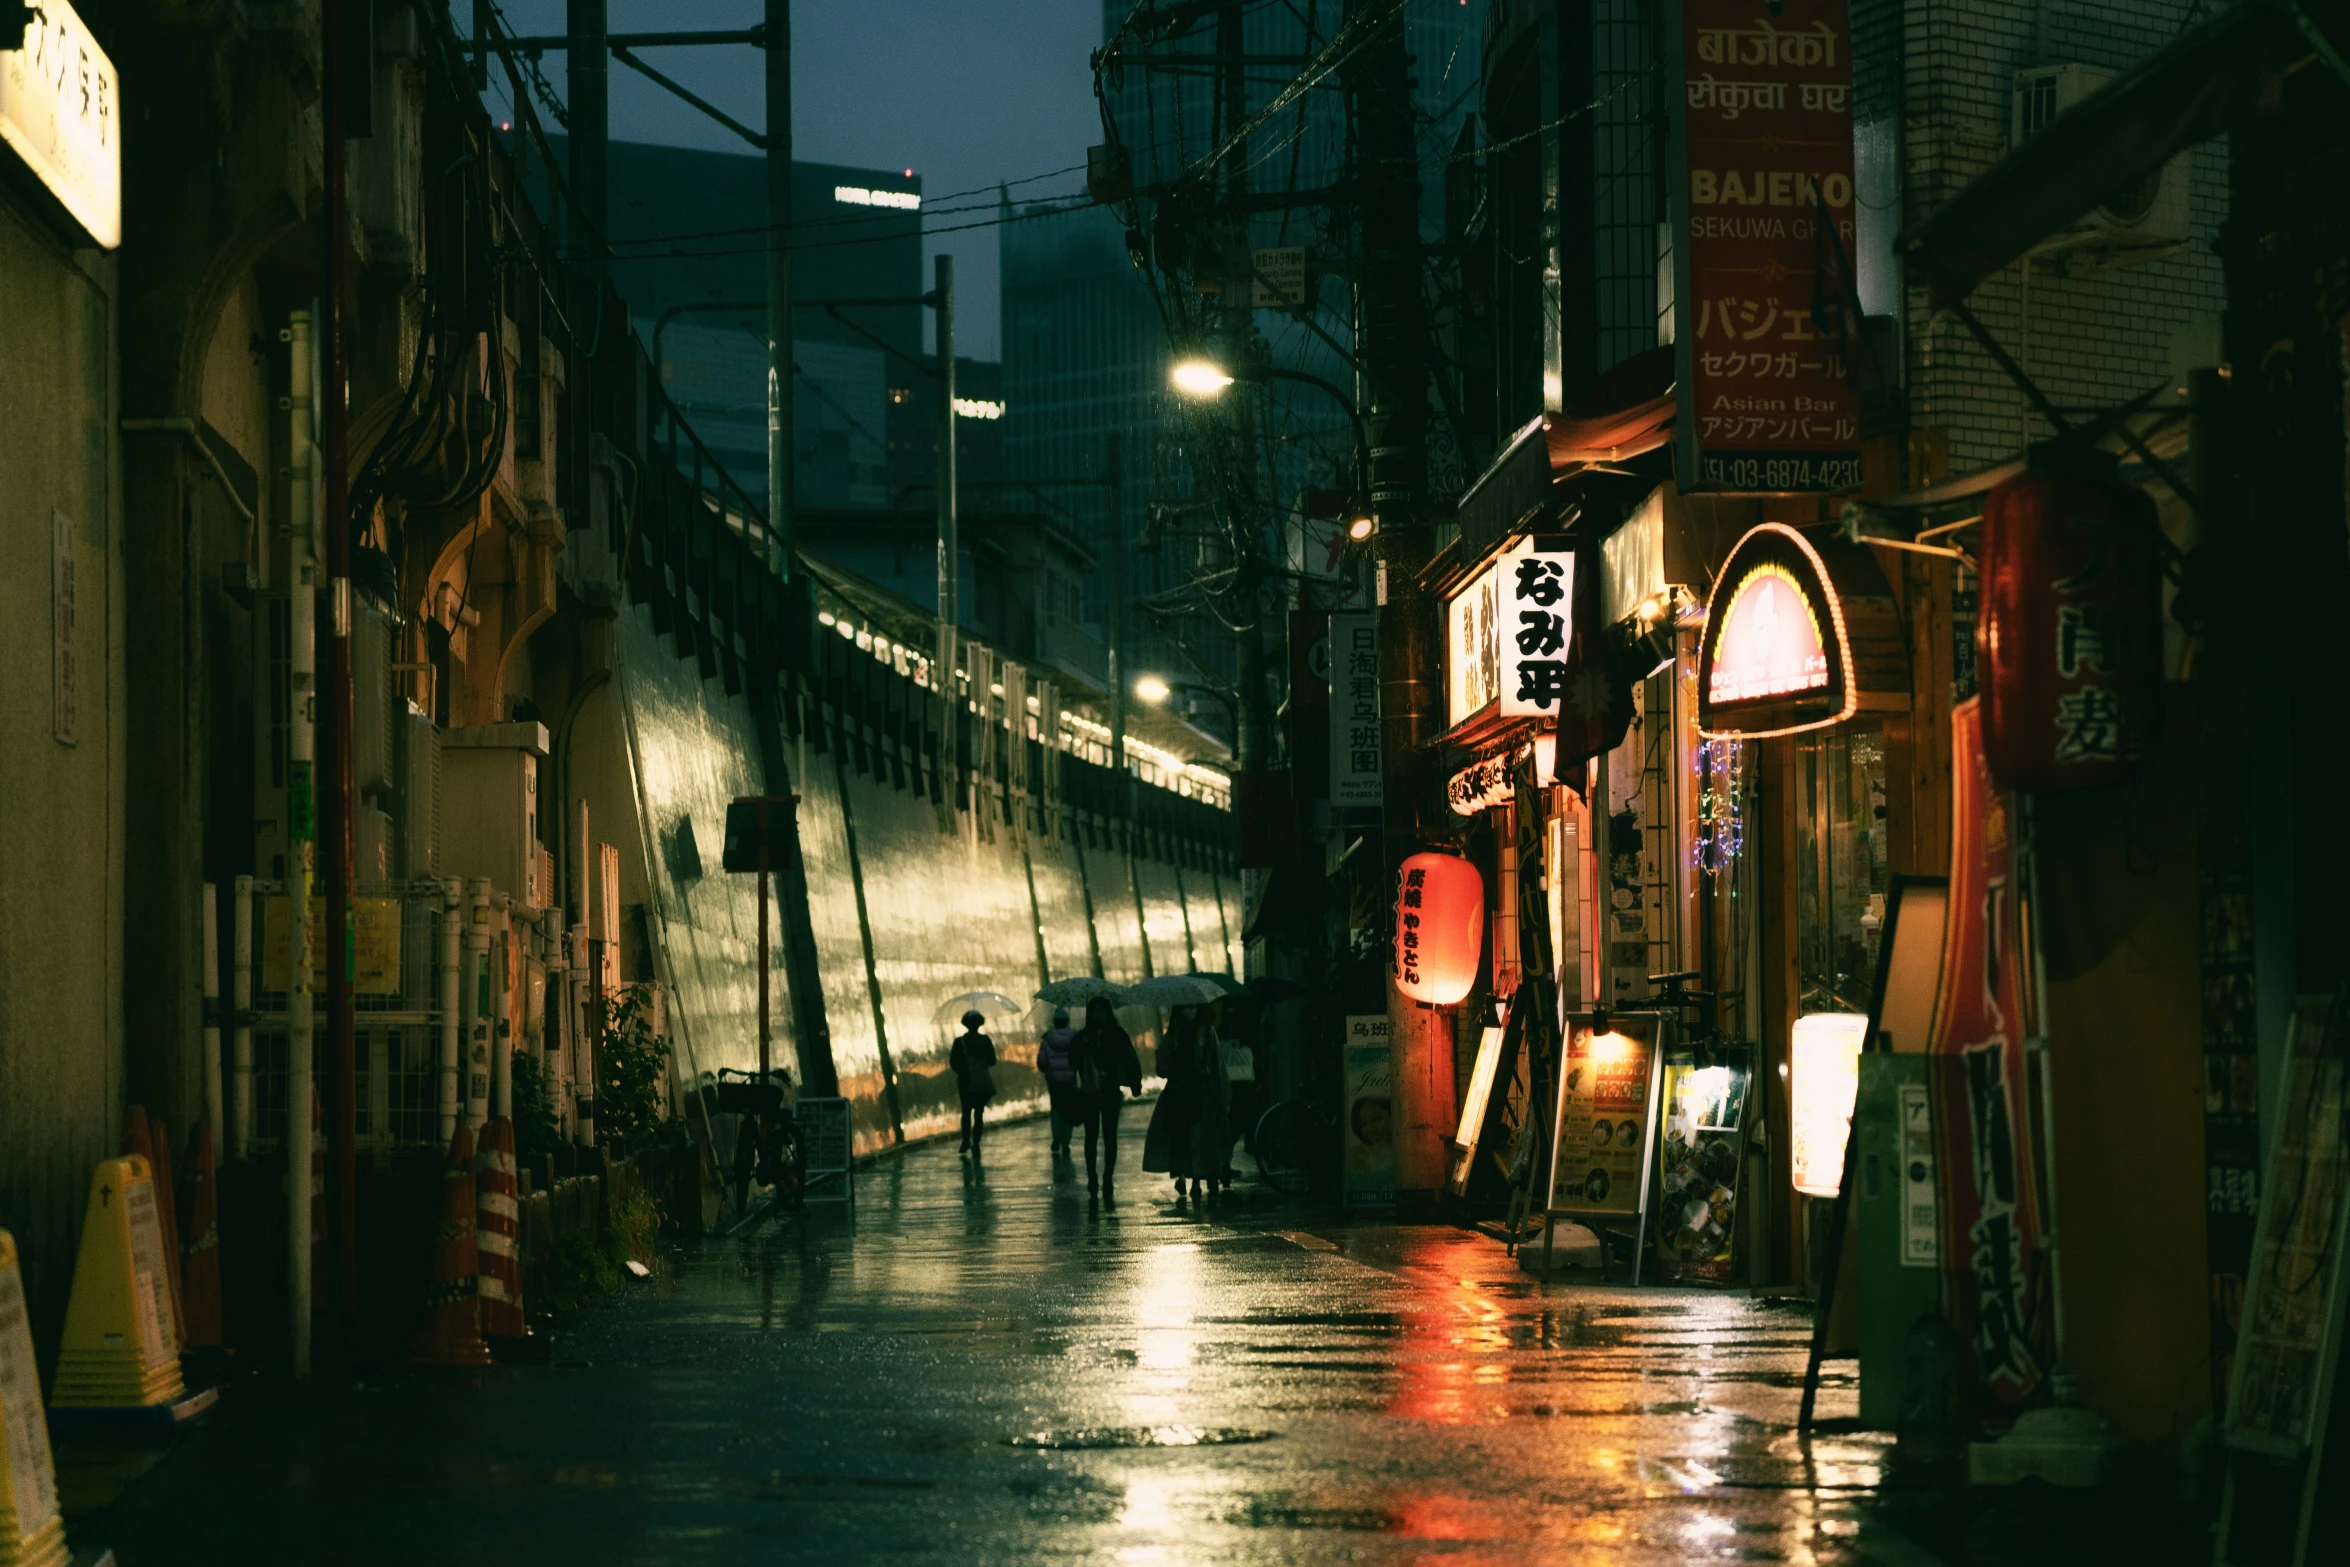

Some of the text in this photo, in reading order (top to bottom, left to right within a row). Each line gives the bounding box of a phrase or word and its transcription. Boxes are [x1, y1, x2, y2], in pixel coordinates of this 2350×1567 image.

[1697, 18, 1839, 68] बाजेको
[1799, 83, 1850, 113] घर
[1691, 169, 1852, 208] BAJEKO
[1690, 216, 1853, 241] SEKUWA GHR
[1700, 350, 1847, 380] セクワガール
[1713, 395, 1838, 412] Asian Bar
[1702, 416, 1855, 441] アジアンバール
[1403, 912, 1421, 985] やきとん
